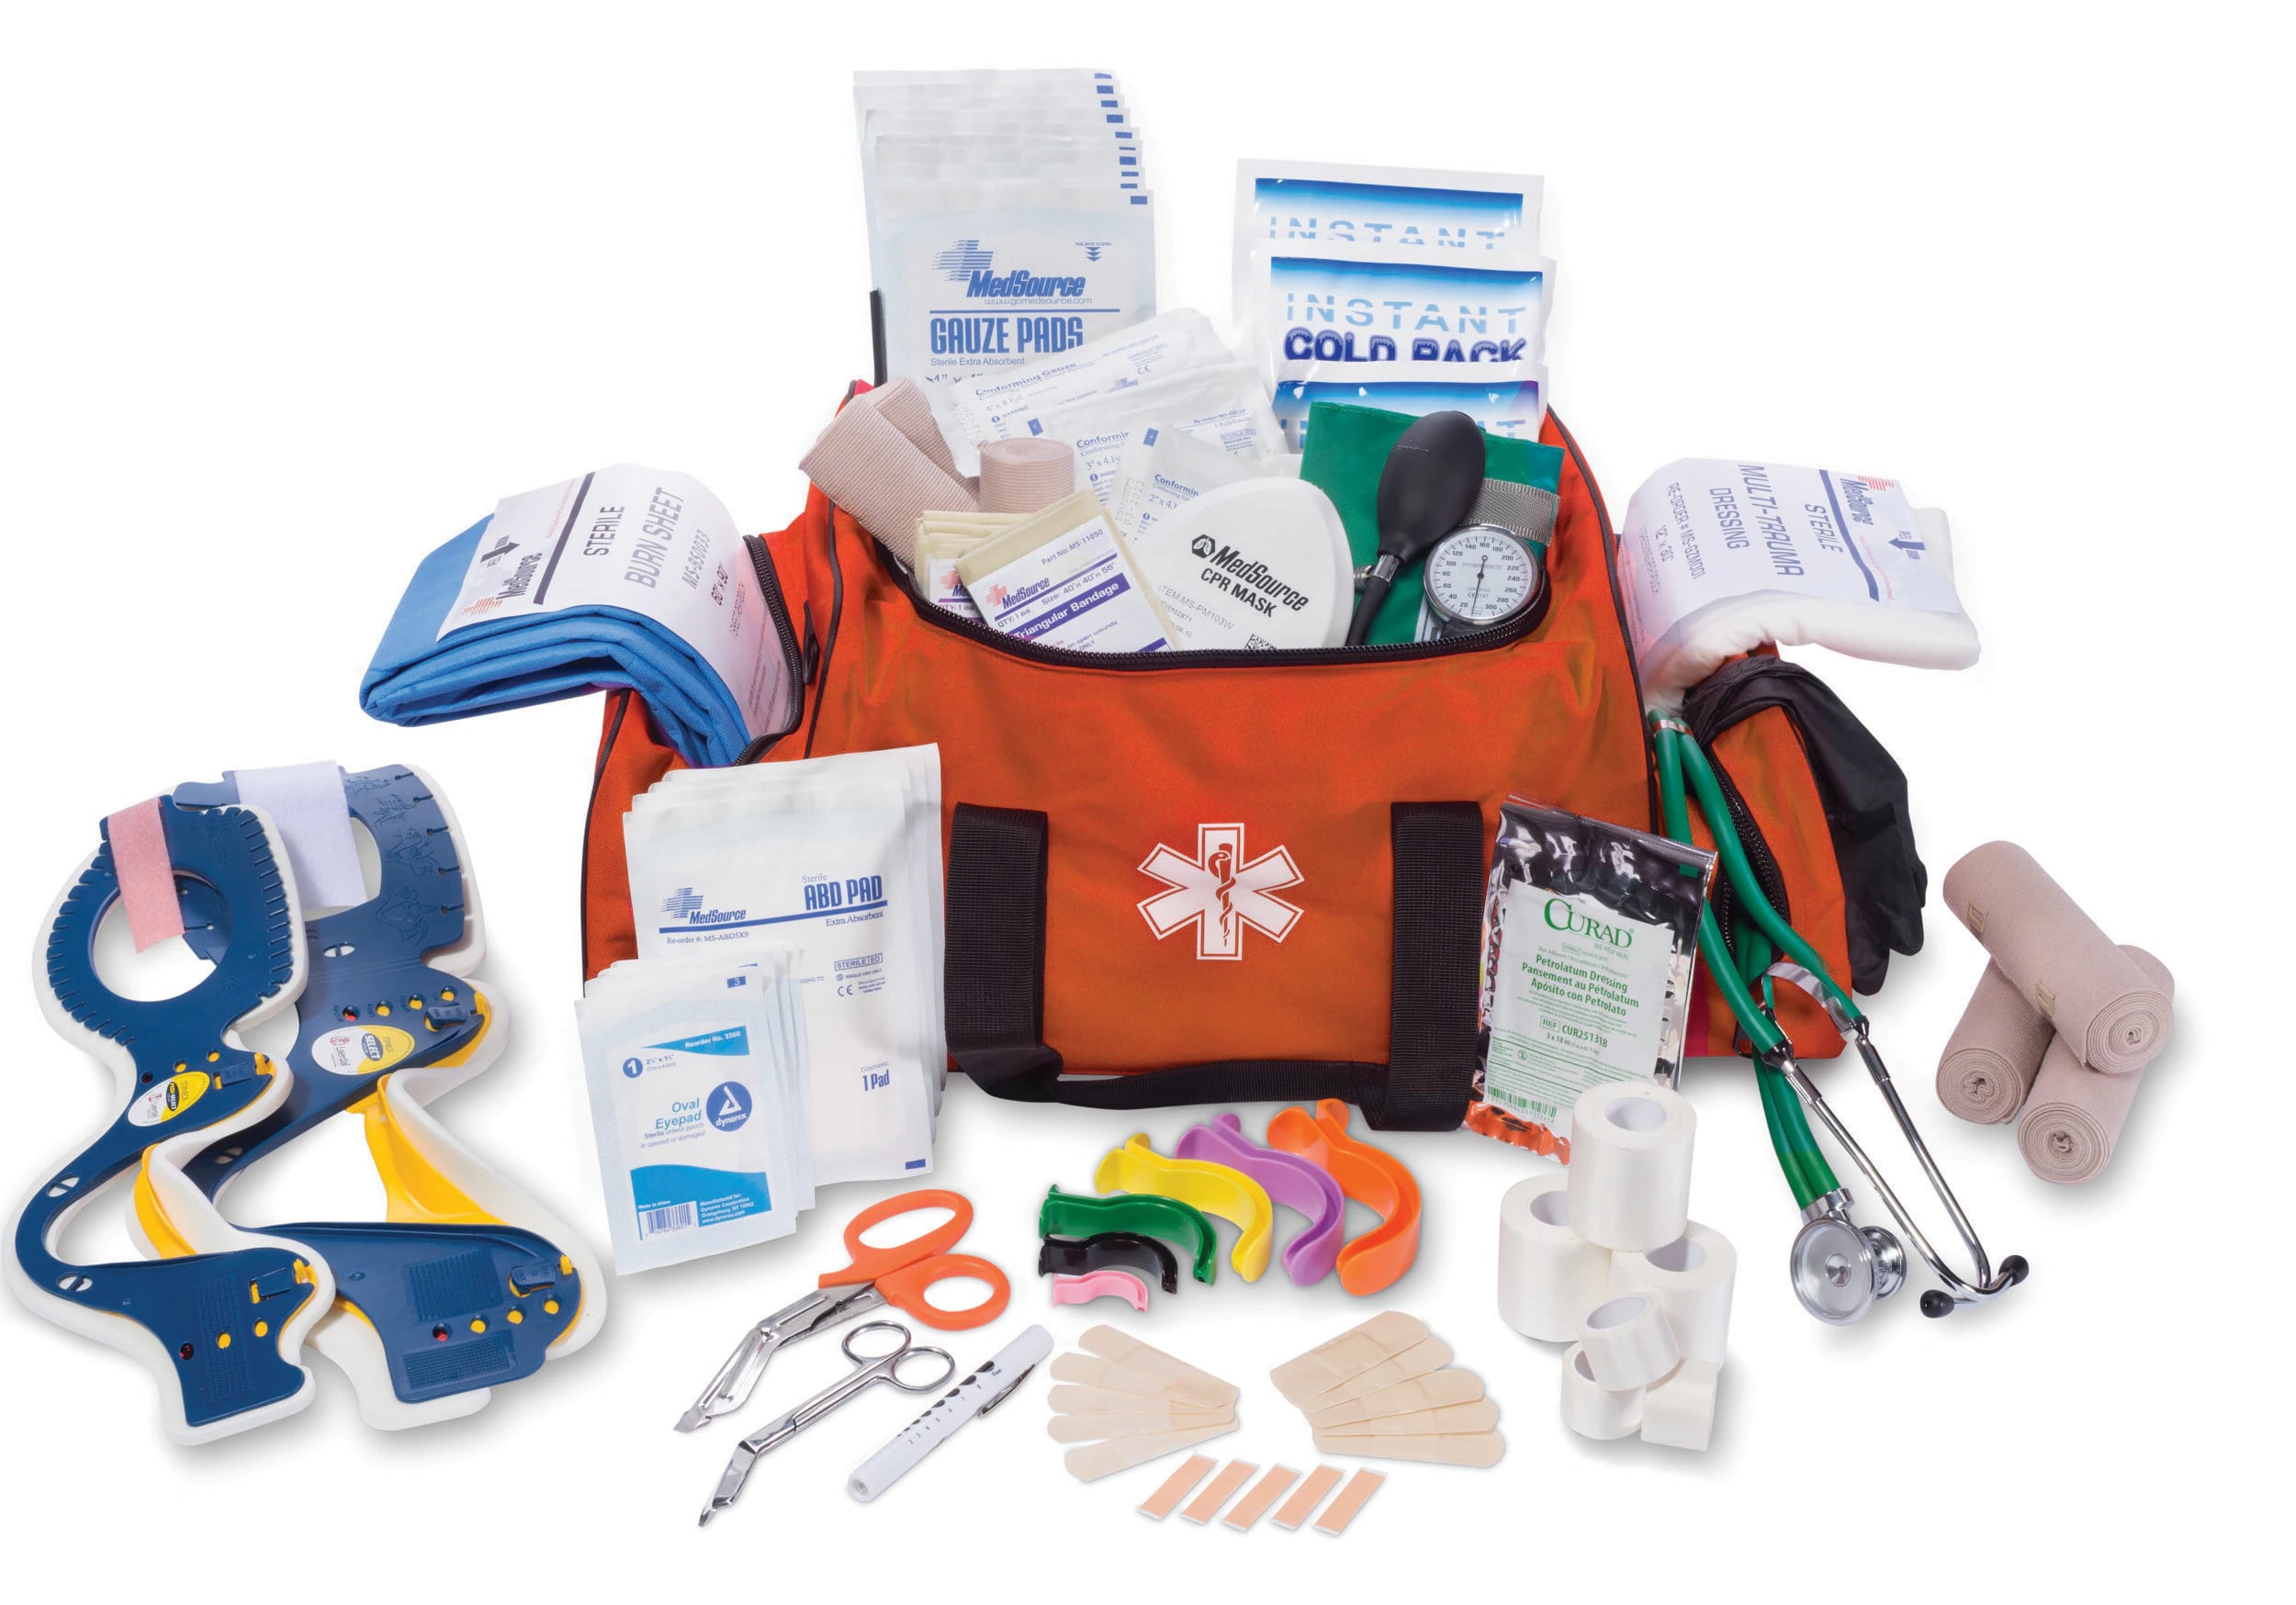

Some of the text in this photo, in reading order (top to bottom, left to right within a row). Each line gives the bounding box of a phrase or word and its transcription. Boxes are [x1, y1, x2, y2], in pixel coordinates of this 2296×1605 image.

[1269, 216, 1504, 250] INSTANT
[966, 270, 1086, 297] MedSource
[985, 297, 1093, 306] www.gomedsource.com
[1288, 293, 1526, 334] INSTANT
[930, 318, 1010, 354] GAUZE
[1017, 316, 1084, 353] PADS
[1284, 326, 1526, 362] COLD PACK
[930, 356, 1026, 366] Sterile Extra Absorbent
[1709, 487, 1750, 550] DRESSING
[1739, 464, 1805, 577] MULTI-TRAUMA
[1804, 503, 1843, 553] STERILE
[583, 506, 625, 556] STERILE
[625, 486, 684, 589] BURN SHEET
[1041, 529, 1104, 565] Part No: MS-11050
[1210, 545, 1310, 612] MedSource
[1002, 578, 1051, 610] MedSource
[1041, 592, 1061, 605] Size:
[1200, 567, 1278, 618] CPR MASK
[997, 615, 1015, 628] QTY:
[1020, 608, 1031, 617] ea
[1013, 581, 1120, 639] Triangular Bandage
[1075, 632, 1094, 645] open
[1093, 621, 1118, 636] wounds
[1079, 640, 1095, 651] ONLY
[802, 872, 828, 883] Sterile
[804, 874, 883, 911] ABD PAD
[689, 909, 747, 925] MedSource
[826, 911, 884, 926] Extra Absorbent
[667, 937, 694, 945] Re-order
[703, 931, 748, 942] MS-ABD5X9
[1604, 946, 1615, 955] HELP
[837, 958, 868, 970] STERILE
[1536, 954, 1588, 979] Petrolatum
[1590, 971, 1628, 993] Dressing
[734, 976, 740, 986] 3
[1522, 962, 1639, 1008] Pansement au Pétrolatum
[1531, 978, 1627, 1016] Apósito con Petrolato
[684, 1038, 712, 1049] Reorder
[1542, 1018, 1608, 1048] REF CUR251318
[1557, 1036, 1564, 1044] 18
[1564, 1038, 1571, 1046] in
[364, 1035, 381, 1060] SELECT
[627, 1059, 638, 1074] 1
[862, 1068, 890, 1091] 1 Pad
[671, 1097, 701, 1113] Oval
[655, 1110, 703, 1130] Eyepad
[715, 1112, 748, 1127] dynarex
[644, 1129, 665, 1139] Sterile
